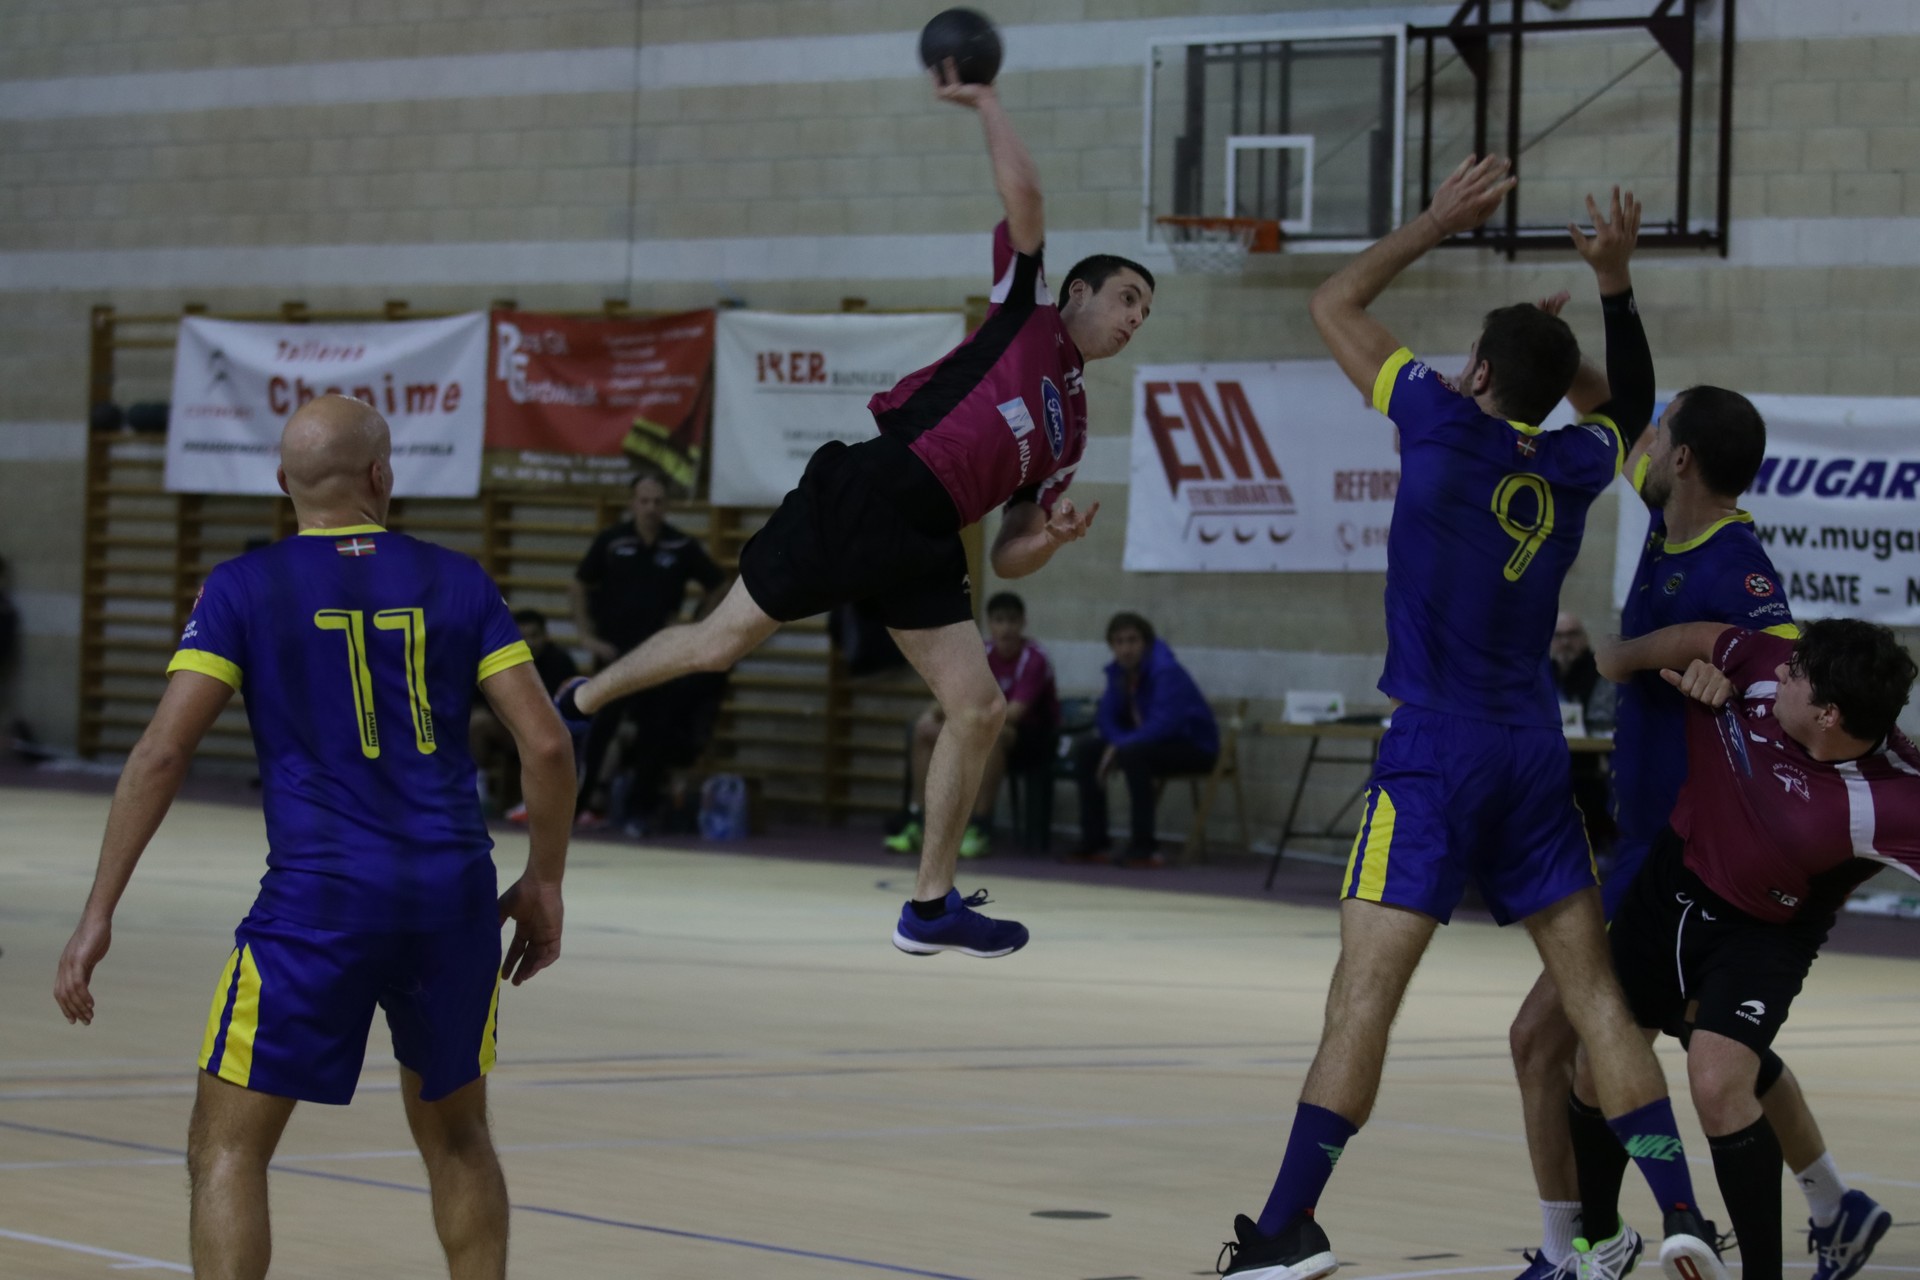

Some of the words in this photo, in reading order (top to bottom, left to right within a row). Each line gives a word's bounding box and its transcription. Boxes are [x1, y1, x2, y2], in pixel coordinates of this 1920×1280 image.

[756, 351, 828, 384] IKER
[1333, 470, 1400, 501] REFOR
[1491, 472, 1555, 582] 9
[314, 608, 437, 760] 11
[1735, 1010, 1761, 1026] ASTORE
[1624, 1134, 1683, 1162] NIKE
